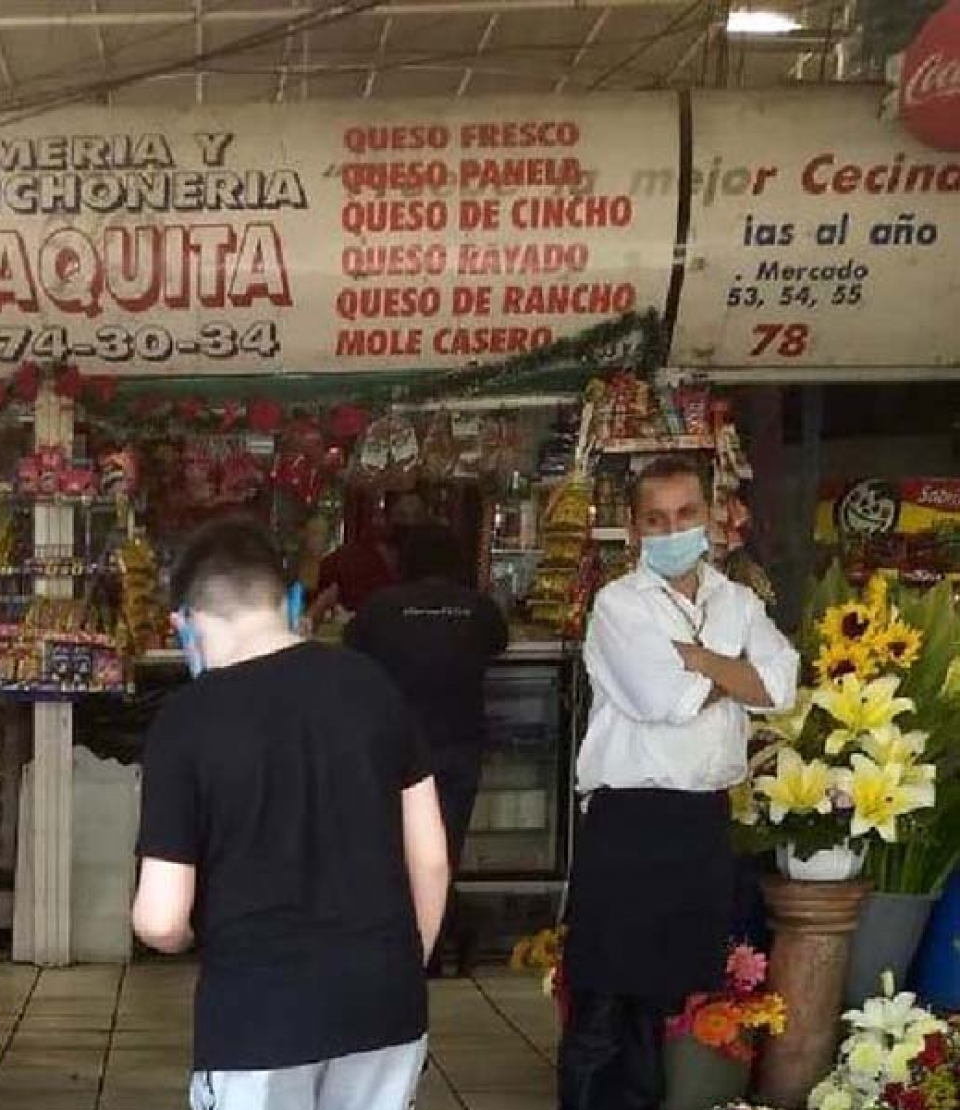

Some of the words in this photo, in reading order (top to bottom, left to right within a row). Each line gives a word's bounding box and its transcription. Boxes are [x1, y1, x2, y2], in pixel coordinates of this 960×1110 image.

[193, 133, 234, 167] Y
[343, 126, 449, 153] QUESO
[459, 122, 581, 148] FRESCO
[341, 160, 449, 192] QUESO
[458, 157, 583, 187] PANELA
[801, 153, 960, 197] Cecina
[341, 200, 448, 234] QUESO
[458, 200, 501, 231] DE
[511, 196, 633, 229] CINCHO
[816, 212, 849, 246] al
[869, 212, 938, 246] año
[341, 245, 446, 278] QUESO
[457, 243, 590, 275] RAYADO
[756, 258, 869, 281] Mercado
[336, 286, 441, 320] QUESO
[452, 286, 492, 317] DE
[502, 281, 637, 316] RANCHO
[727, 287, 764, 308] 53,
[779, 285, 818, 308] 54,
[831, 284, 862, 305] 55
[336, 328, 423, 356] MOLE
[432, 327, 554, 356] CASERO
[749, 323, 809, 358] 78
